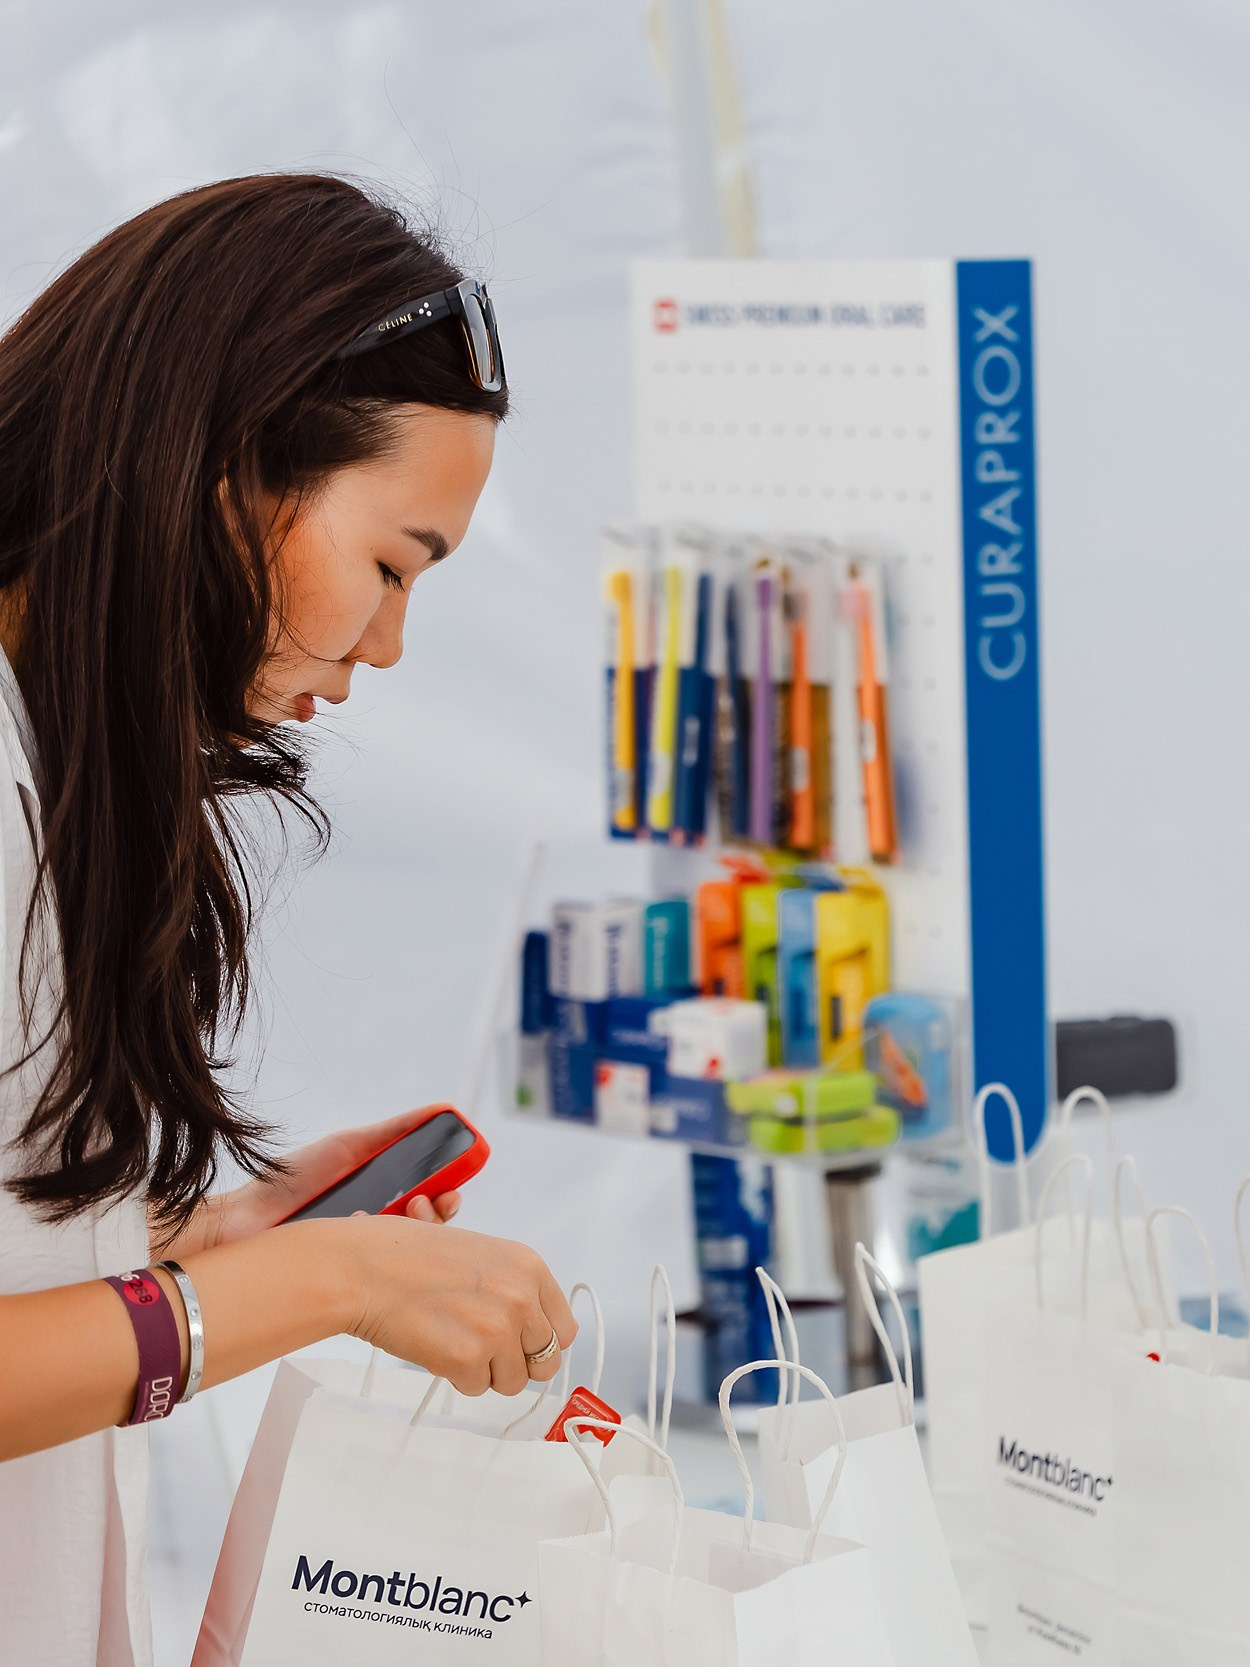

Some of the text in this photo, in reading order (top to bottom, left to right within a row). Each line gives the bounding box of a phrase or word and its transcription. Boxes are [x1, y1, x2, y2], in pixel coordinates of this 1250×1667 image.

[973, 304, 1027, 680] CURAPROX
[997, 1435, 1105, 1501] Montblanc
[291, 1555, 515, 1622] Montblanc
[303, 1601, 493, 1639] стоматологиялық клиника
